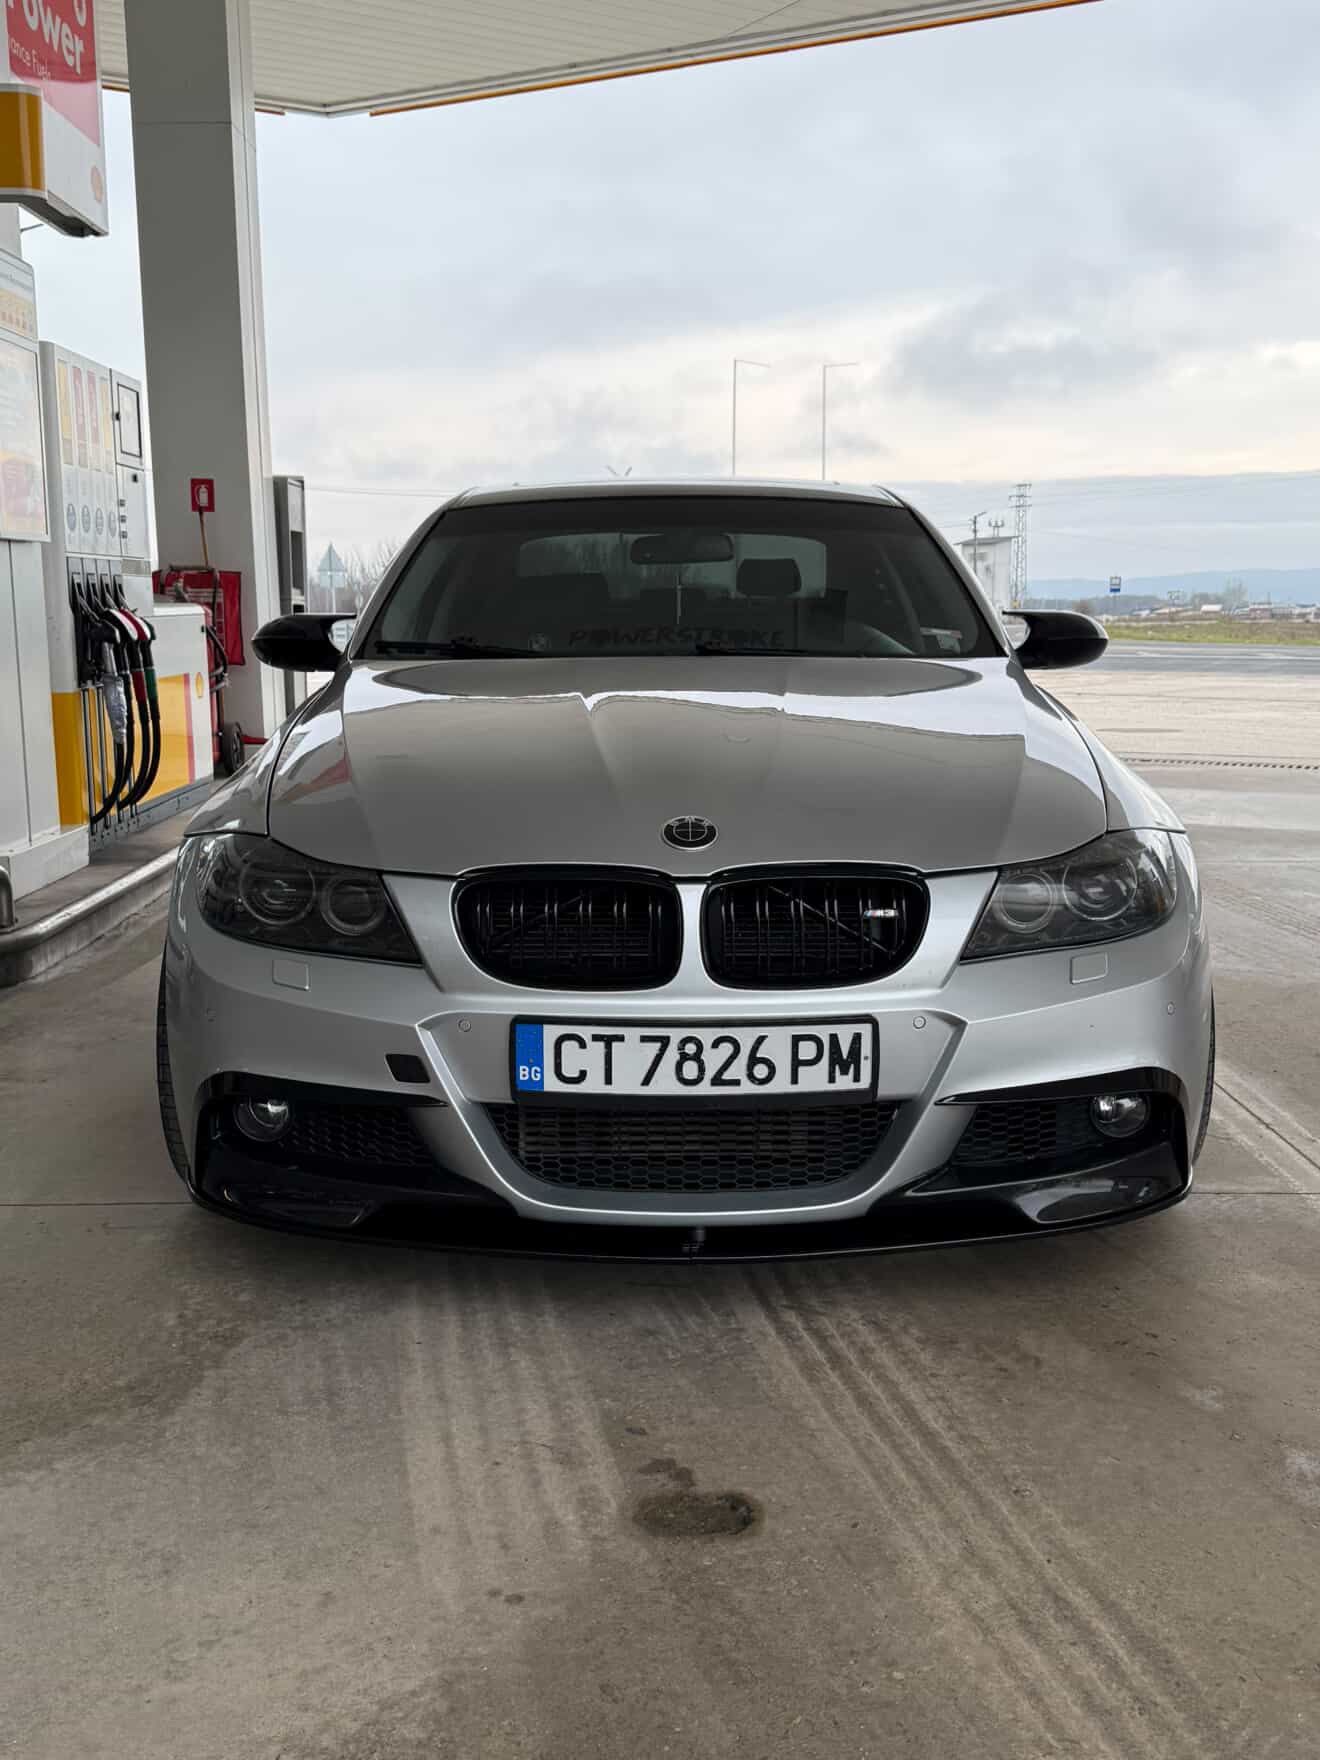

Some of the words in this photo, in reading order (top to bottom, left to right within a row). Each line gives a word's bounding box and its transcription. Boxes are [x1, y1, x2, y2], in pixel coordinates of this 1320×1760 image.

[8, 0, 84, 76] ower
[519, 1065, 542, 1082] BG
[553, 1033, 625, 1086] CT
[639, 1034, 777, 1087] 7826
[790, 1032, 863, 1085] PM
